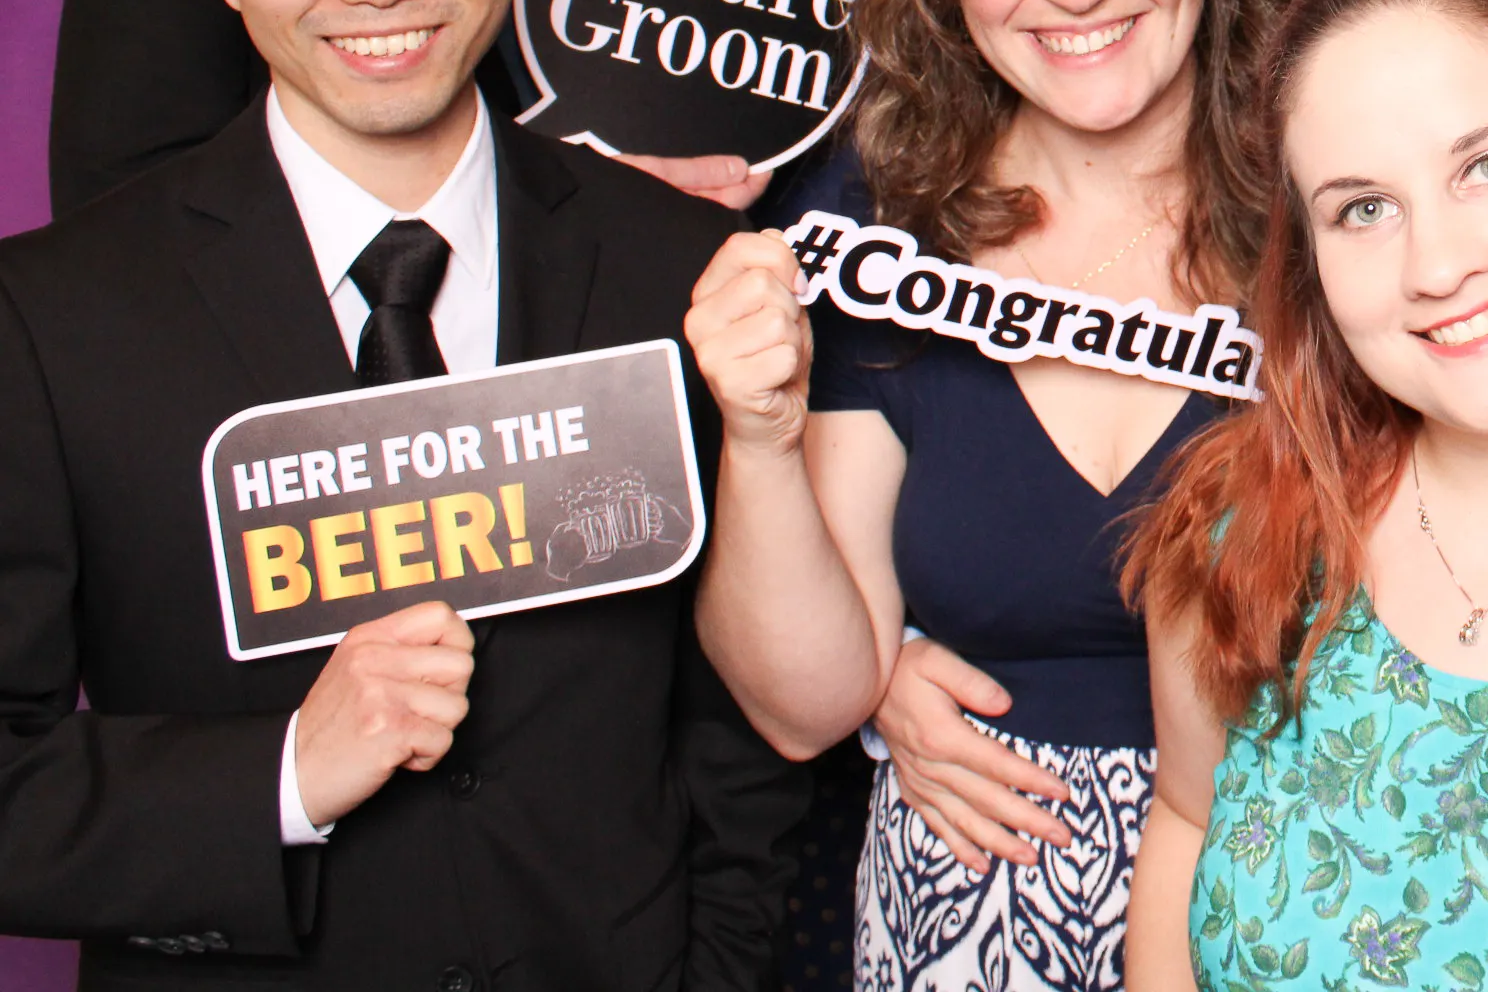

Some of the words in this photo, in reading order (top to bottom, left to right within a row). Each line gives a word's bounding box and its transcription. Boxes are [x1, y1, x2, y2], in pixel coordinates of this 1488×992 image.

[232, 443, 372, 512] HERE
[381, 425, 485, 486] FOR
[493, 406, 590, 464] THE
[242, 483, 534, 614] BEER!
